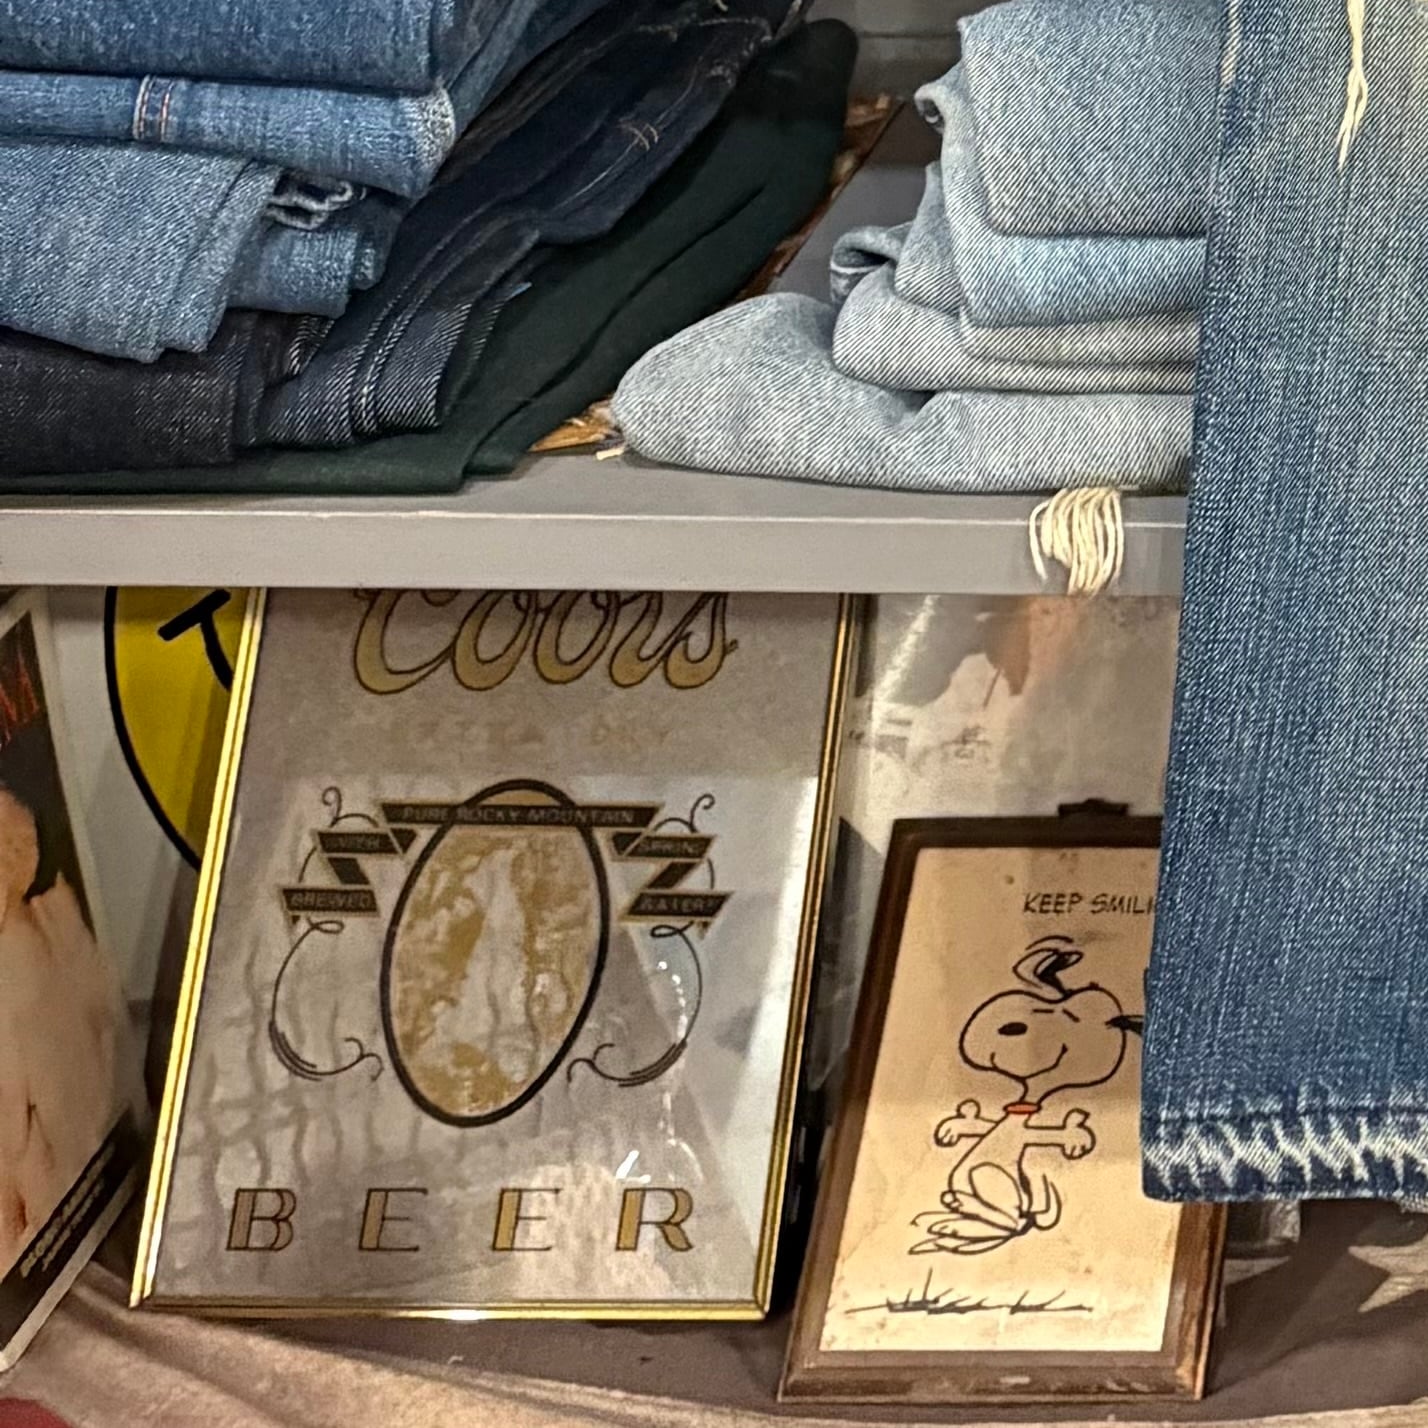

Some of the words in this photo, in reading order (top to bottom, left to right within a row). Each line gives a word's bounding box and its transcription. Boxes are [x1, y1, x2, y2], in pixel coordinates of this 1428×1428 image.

[1023, 892, 1083, 914] KEEP
[1090, 892, 1156, 914] SMILI
[226, 1187, 694, 1252] BEER
